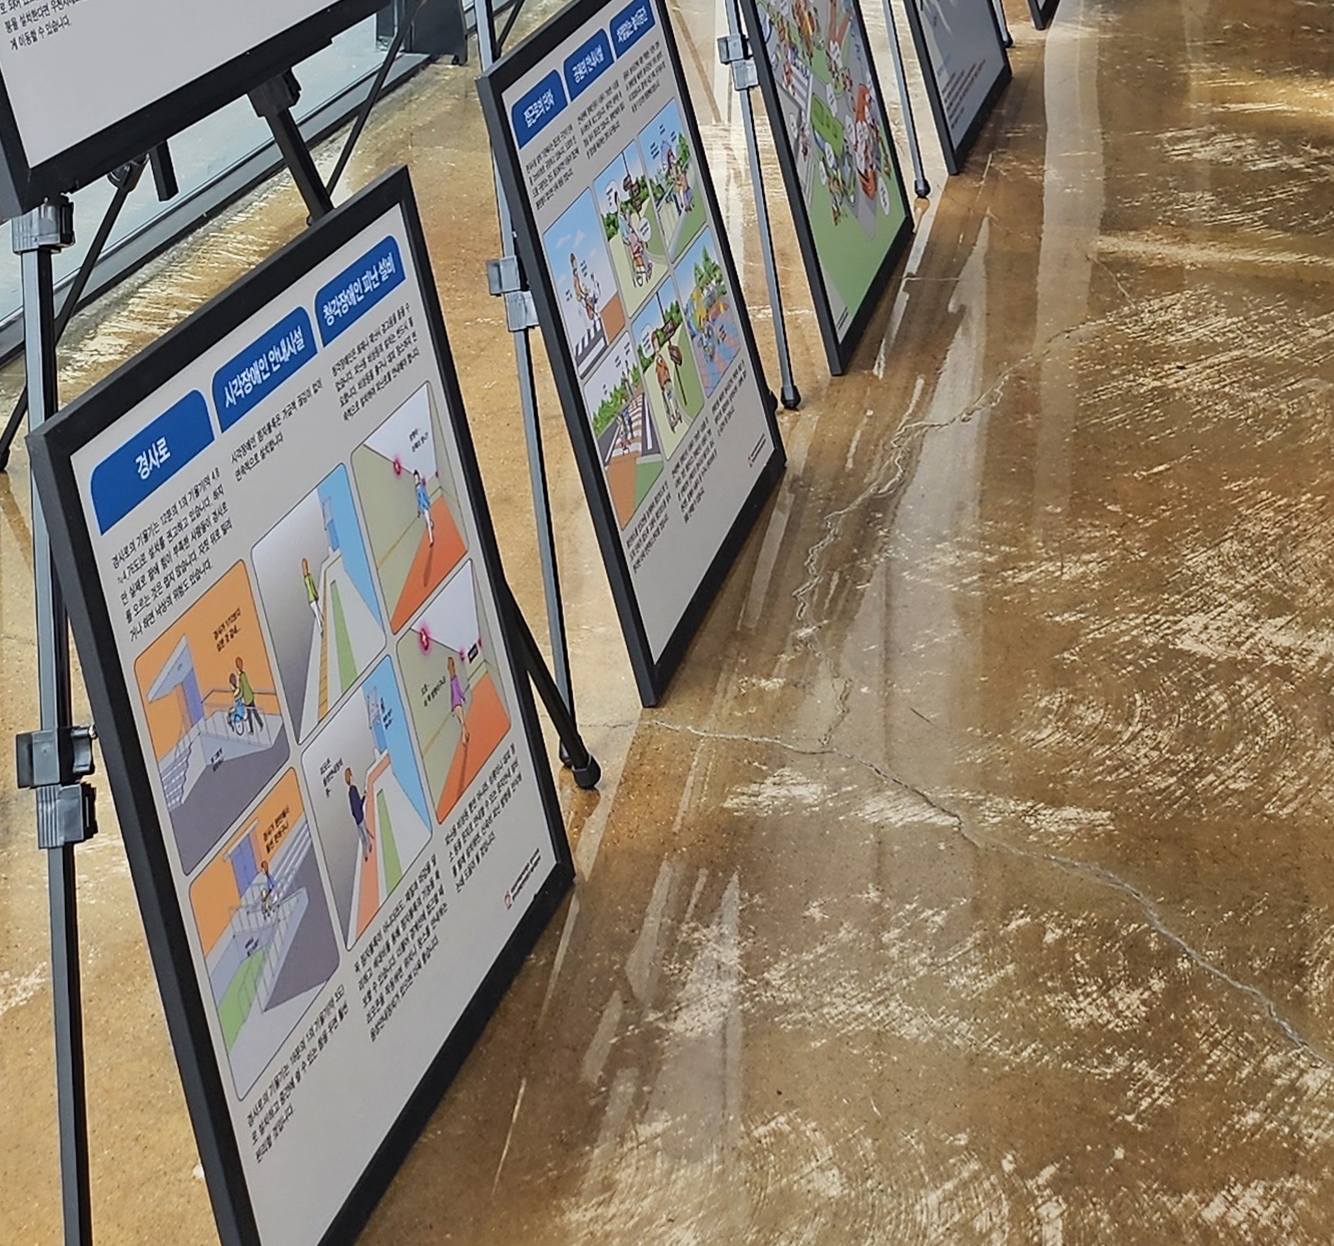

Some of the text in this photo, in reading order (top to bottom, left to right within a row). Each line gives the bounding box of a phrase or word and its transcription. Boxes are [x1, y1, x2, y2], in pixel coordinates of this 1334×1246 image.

[322, 252, 397, 327] 청각장애인 피난 설비
[224, 354, 269, 409] 시각장애인
[268, 329, 306, 373] 안내시설
[135, 436, 171, 480] 경사로
